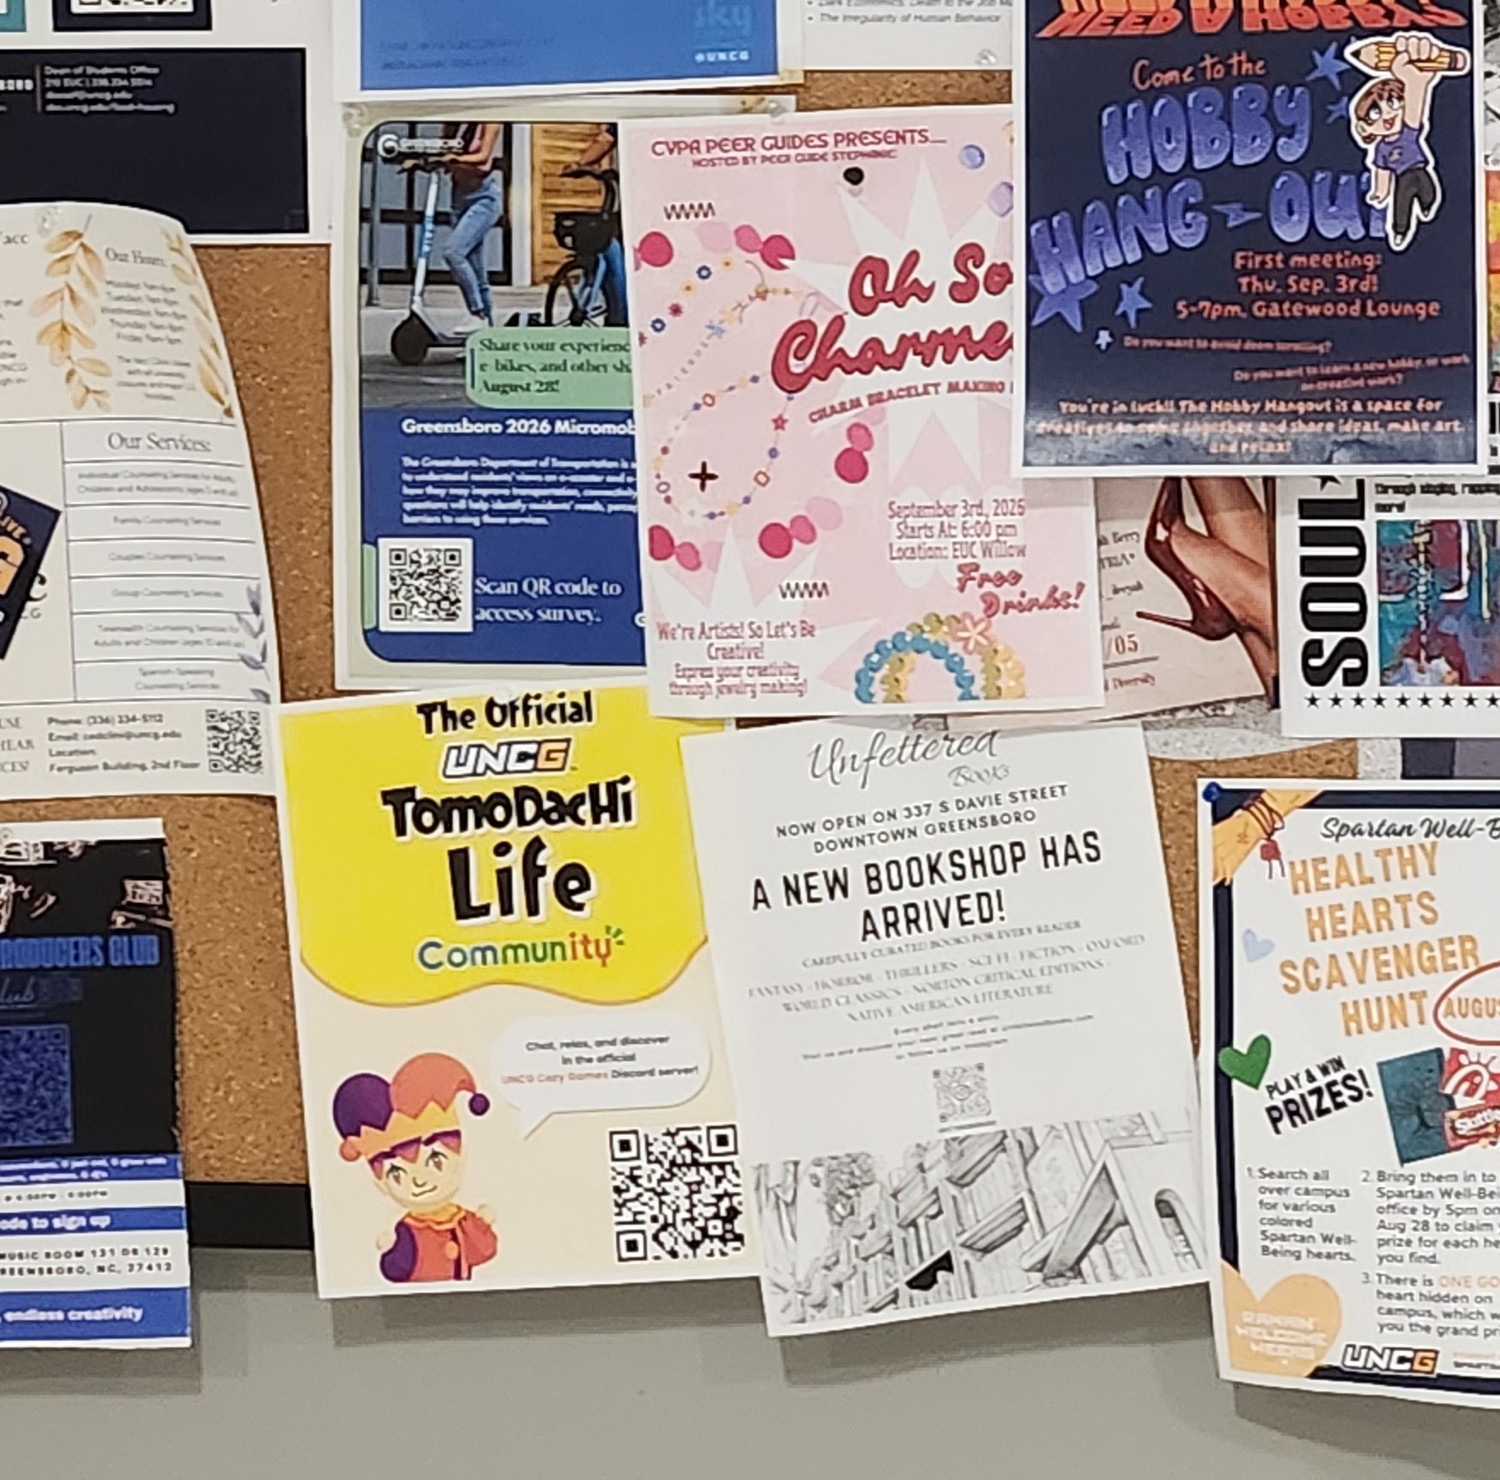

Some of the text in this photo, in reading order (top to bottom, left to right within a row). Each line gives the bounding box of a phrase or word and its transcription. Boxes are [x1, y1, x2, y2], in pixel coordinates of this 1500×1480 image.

[651, 133, 829, 158] CVPA PEER GUIDES
[1102, 83, 1311, 186] HOBBY
[1234, 250, 1382, 273] First meeting:
[1252, 298, 1441, 319] Gatewood Lounge
[474, 578, 622, 599] Scan QR code to
[980, 582, 1085, 618] Drinks!
[416, 691, 595, 736] The Official
[448, 836, 594, 921] Life
[751, 831, 1102, 910] A NEW BOOKSHOP HAS
[1289, 842, 1439, 896] HEALTHY
[860, 889, 1006, 942] ARRIVED!
[1305, 891, 1440, 942] HEARTS
[416, 929, 613, 972] Community
[1279, 934, 1481, 996] SCAVENGER
[1340, 990, 1429, 1037] HUNT
[1377, 1236, 1414, 1249] prize
[1418, 1236, 1439, 1248] for
[1442, 1238, 1480, 1248] each
